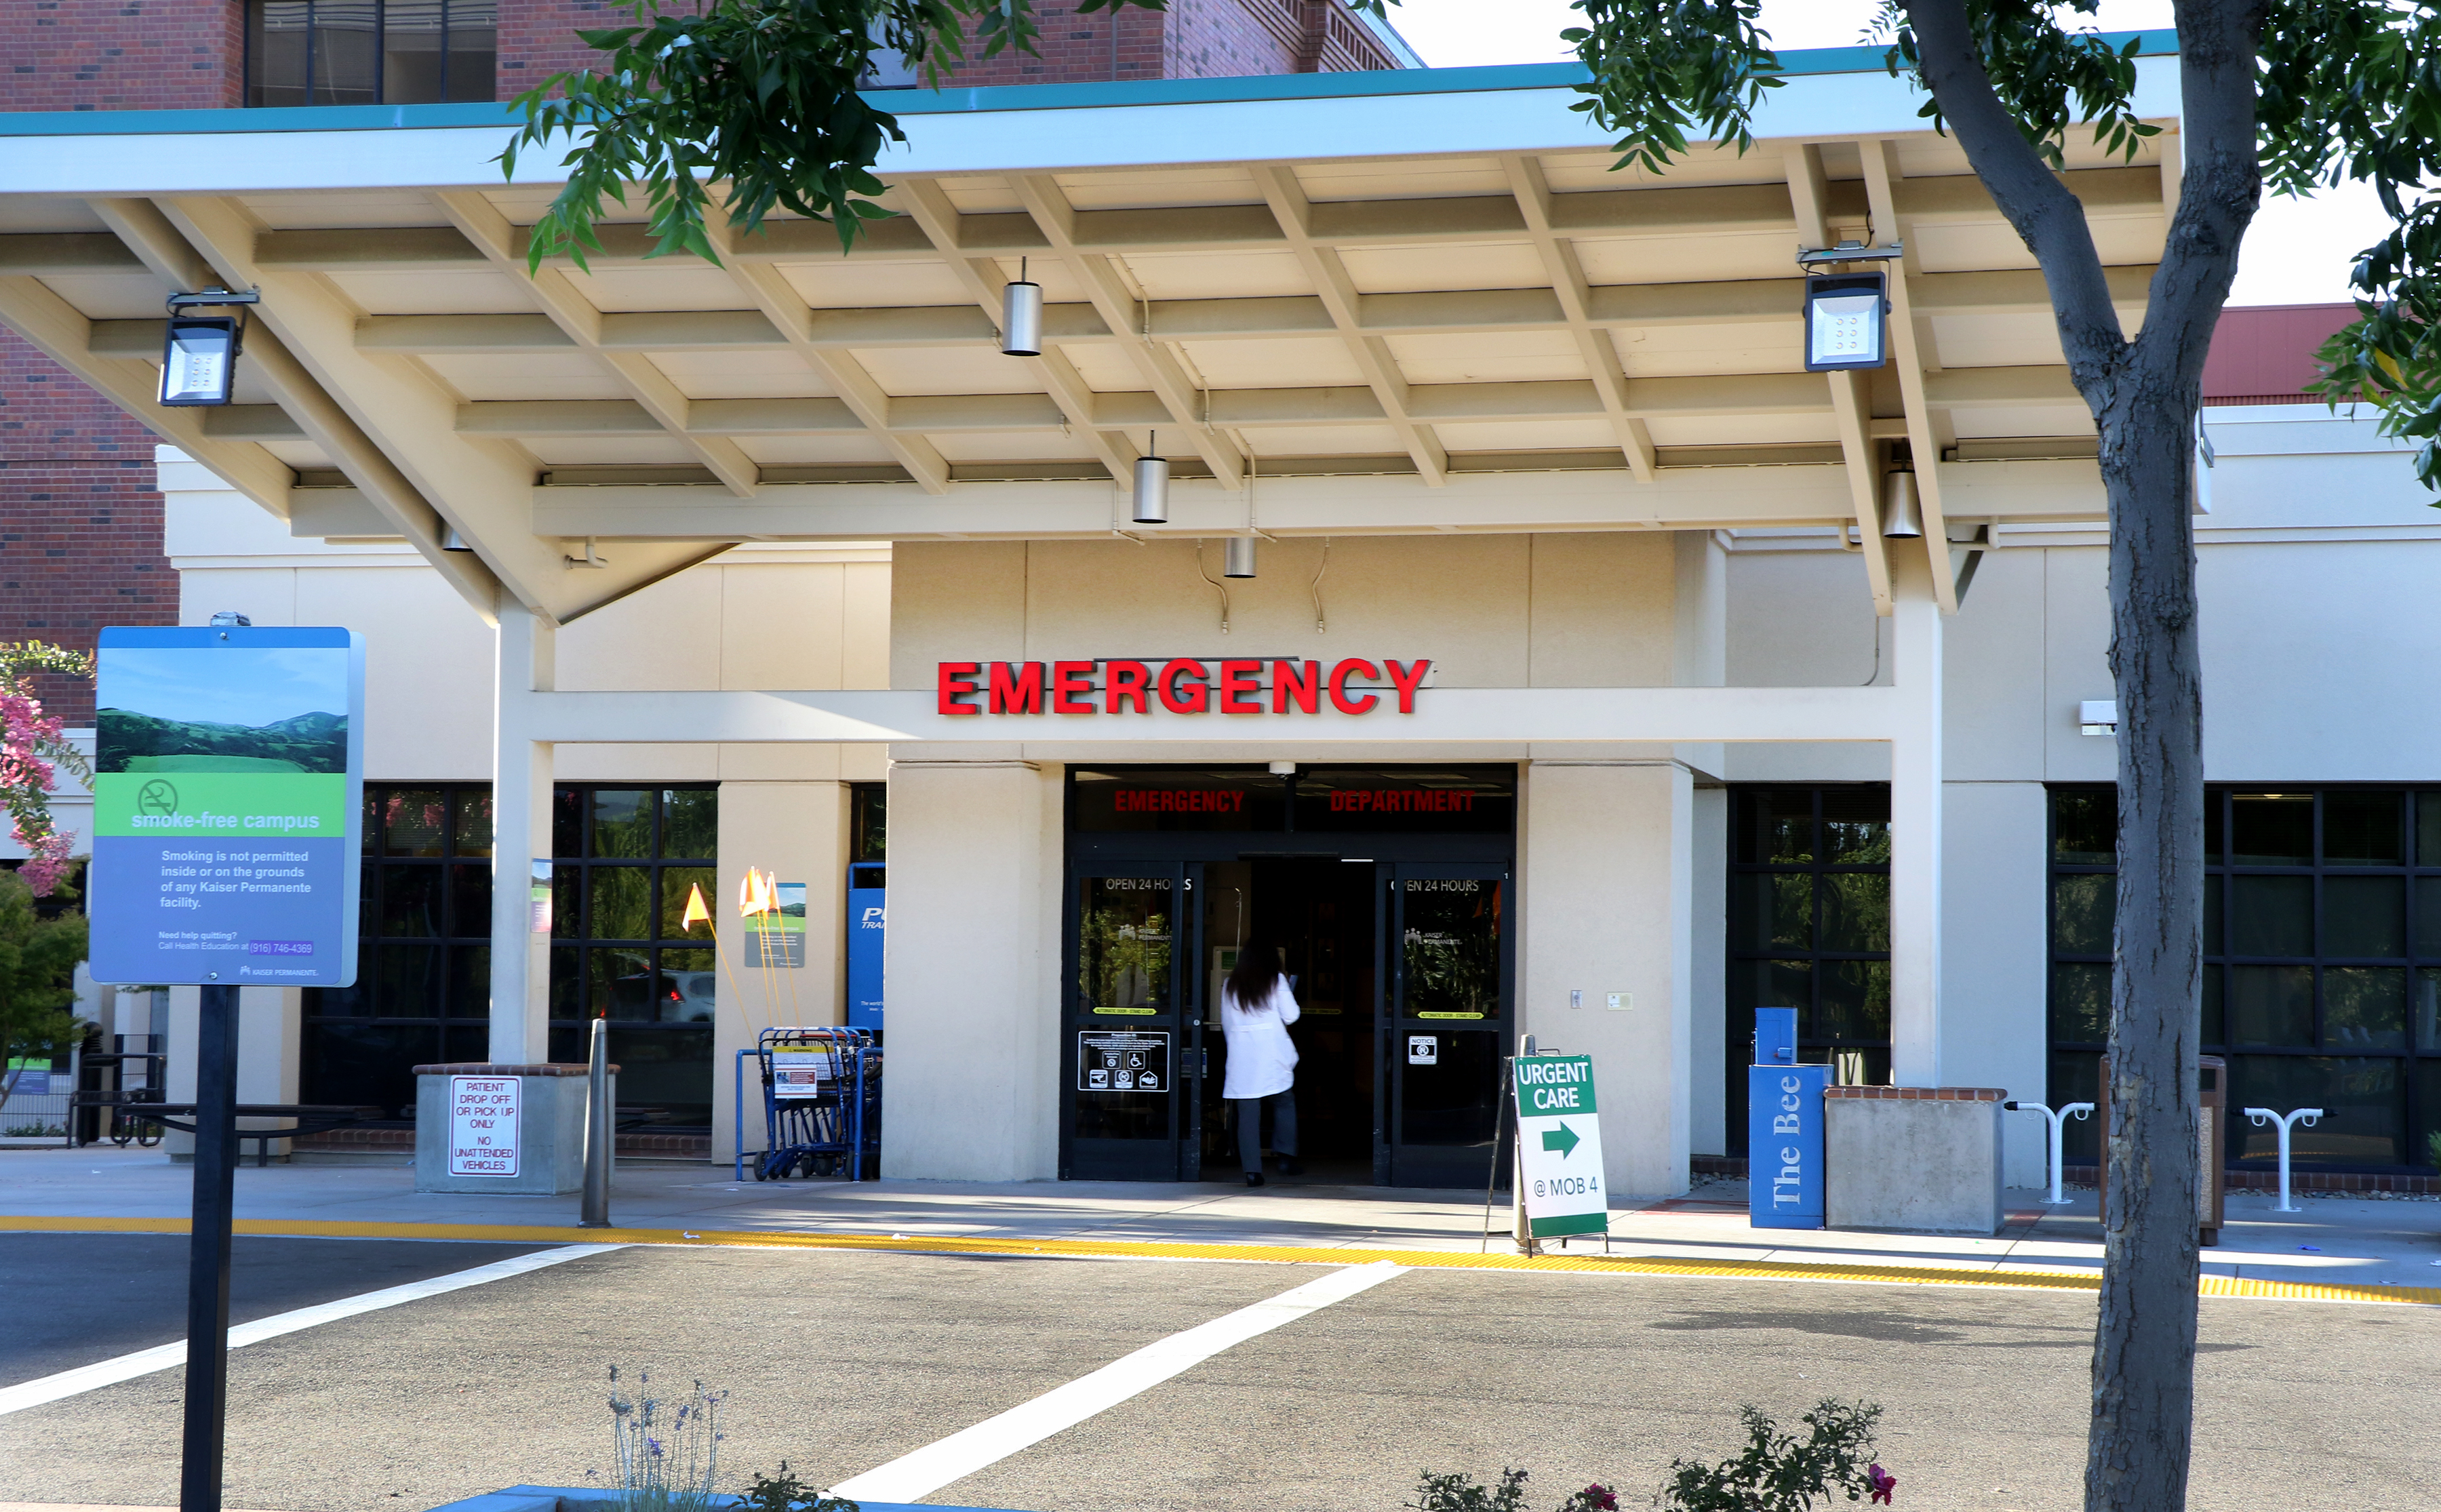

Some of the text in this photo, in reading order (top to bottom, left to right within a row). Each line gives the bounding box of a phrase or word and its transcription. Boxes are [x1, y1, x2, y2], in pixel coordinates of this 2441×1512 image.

[938, 658, 1431, 716] EMERGENCY
[1114, 790, 1475, 812] EMERGENCY DEPARTMENT
[131, 811, 320, 832] smoke-free campus
[161, 850, 309, 863] Smoking is not permitted
[161, 866, 304, 879] inside or on the grounds
[161, 881, 311, 894] of any Kaiser Permanente
[1106, 878, 1191, 890] OPEN 24 HOS
[1425, 880, 1438, 891] 24
[1441, 880, 1479, 892] HOURS
[160, 896, 201, 910] facility.
[181, 932, 199, 940] help
[201, 932, 237, 940] quitting?
[250, 942, 312, 954] (916) 746-4369
[1519, 1062, 1588, 1085] URGENT
[467, 1082, 505, 1092] PATIENT
[460, 1094, 511, 1104] DROP OFF
[1534, 1088, 1580, 1110] CARE
[456, 1107, 514, 1117] OR PICK UP
[470, 1119, 495, 1128] ONLY
[477, 1136, 492, 1145] NO
[1774, 1075, 1801, 1211] The Bee
[454, 1148, 514, 1158] UNATTENDED
[462, 1160, 506, 1170] VEHICLES
[1534, 1176, 1598, 1197] @ MOB 4
